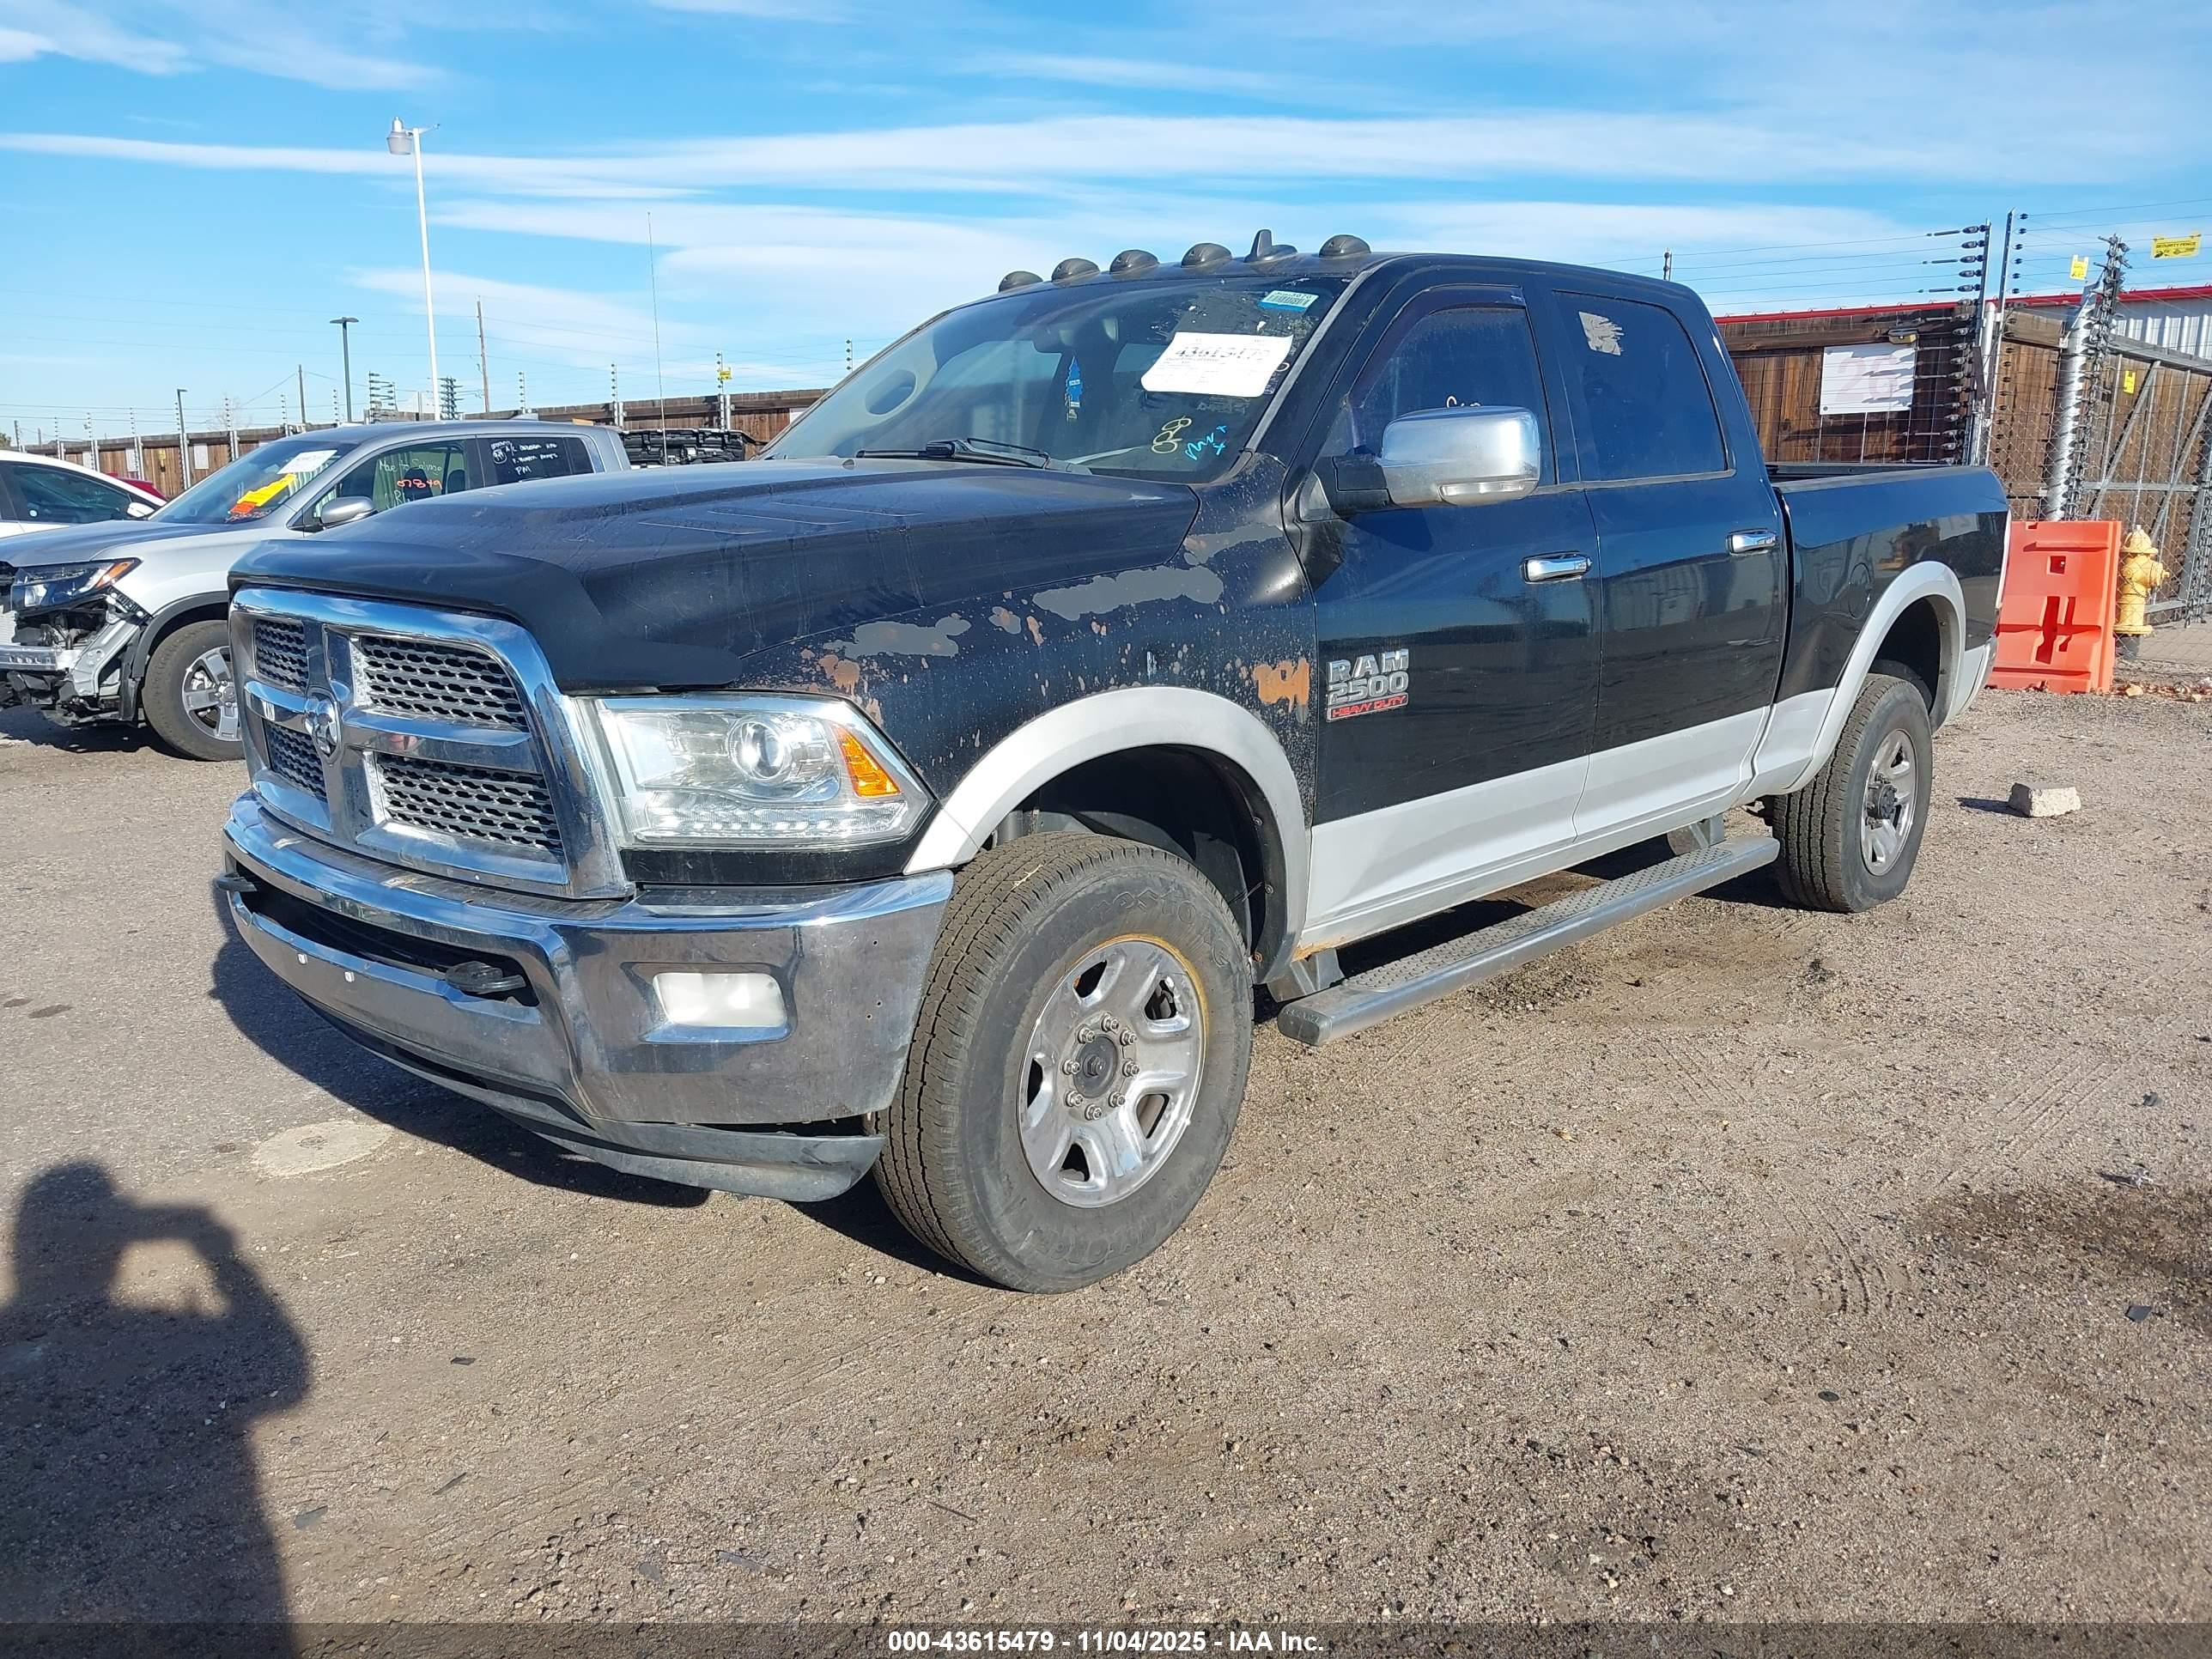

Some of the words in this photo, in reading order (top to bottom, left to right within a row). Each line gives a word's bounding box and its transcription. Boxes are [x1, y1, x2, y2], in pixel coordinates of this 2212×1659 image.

[1328, 648, 1409, 684] RAM
[1328, 671, 1409, 705] 2500
[1332, 702, 1373, 718] HEAVY
[1373, 695, 1407, 709] DUTY
